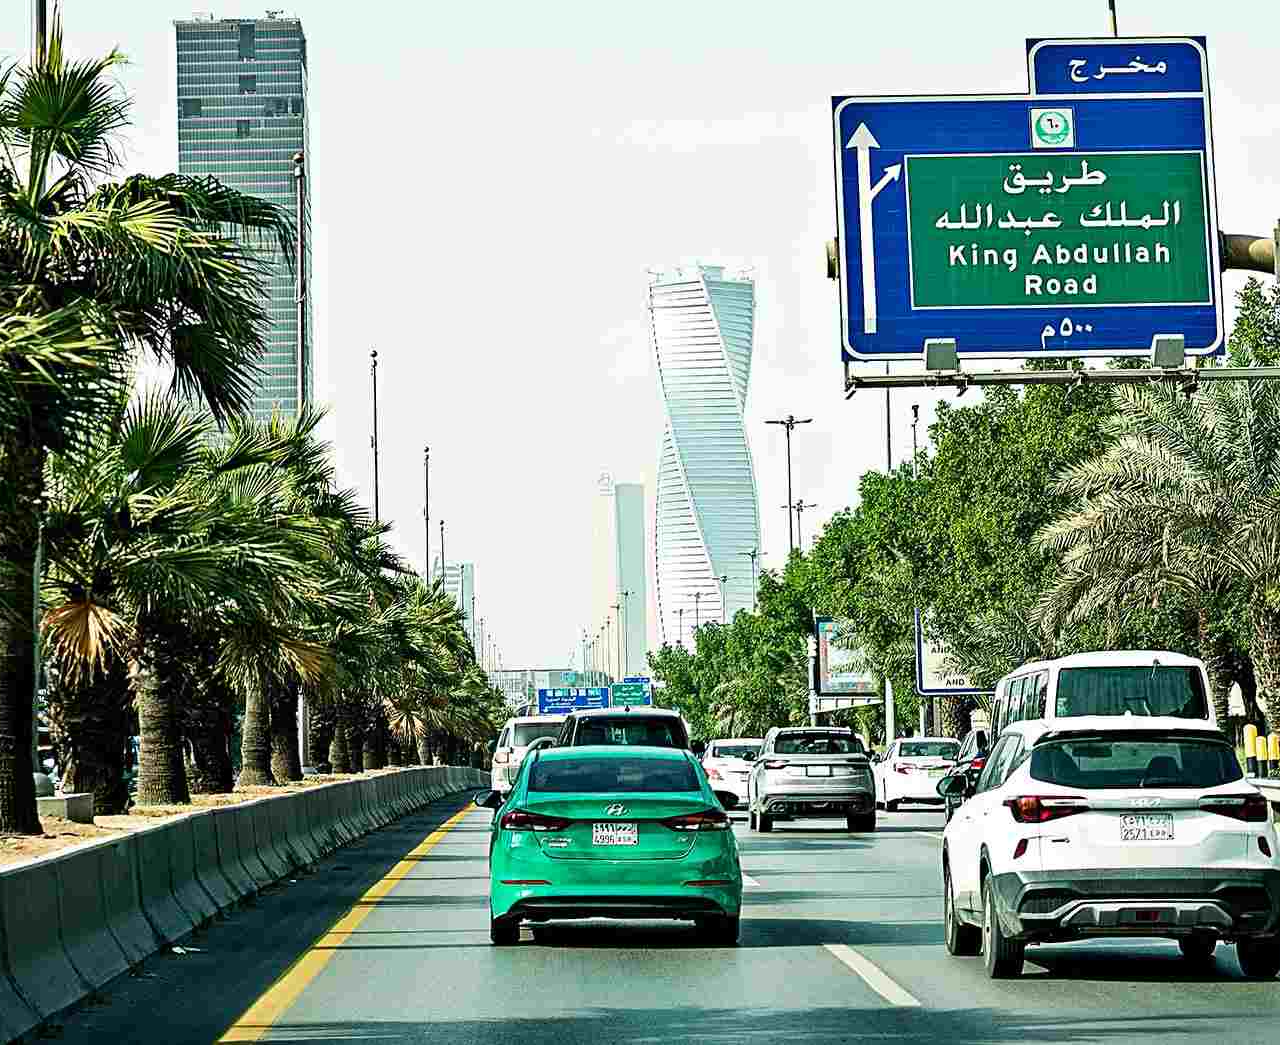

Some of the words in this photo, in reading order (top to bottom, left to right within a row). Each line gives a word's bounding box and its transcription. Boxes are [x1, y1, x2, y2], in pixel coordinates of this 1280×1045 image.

[1068, 56, 1167, 82] مخرج
[1003, 159, 1107, 193] طريق
[935, 203, 1062, 236] عبدالله
[1079, 200, 1181, 230] الملك
[948, 244, 1018, 272] King
[1031, 243, 1171, 265] Abdullah
[1024, 274, 1098, 295] Road
[1039, 325, 1057, 349] م
[1060, 317, 1094, 337] ٥٠٠
[945, 678, 965, 687] AND
